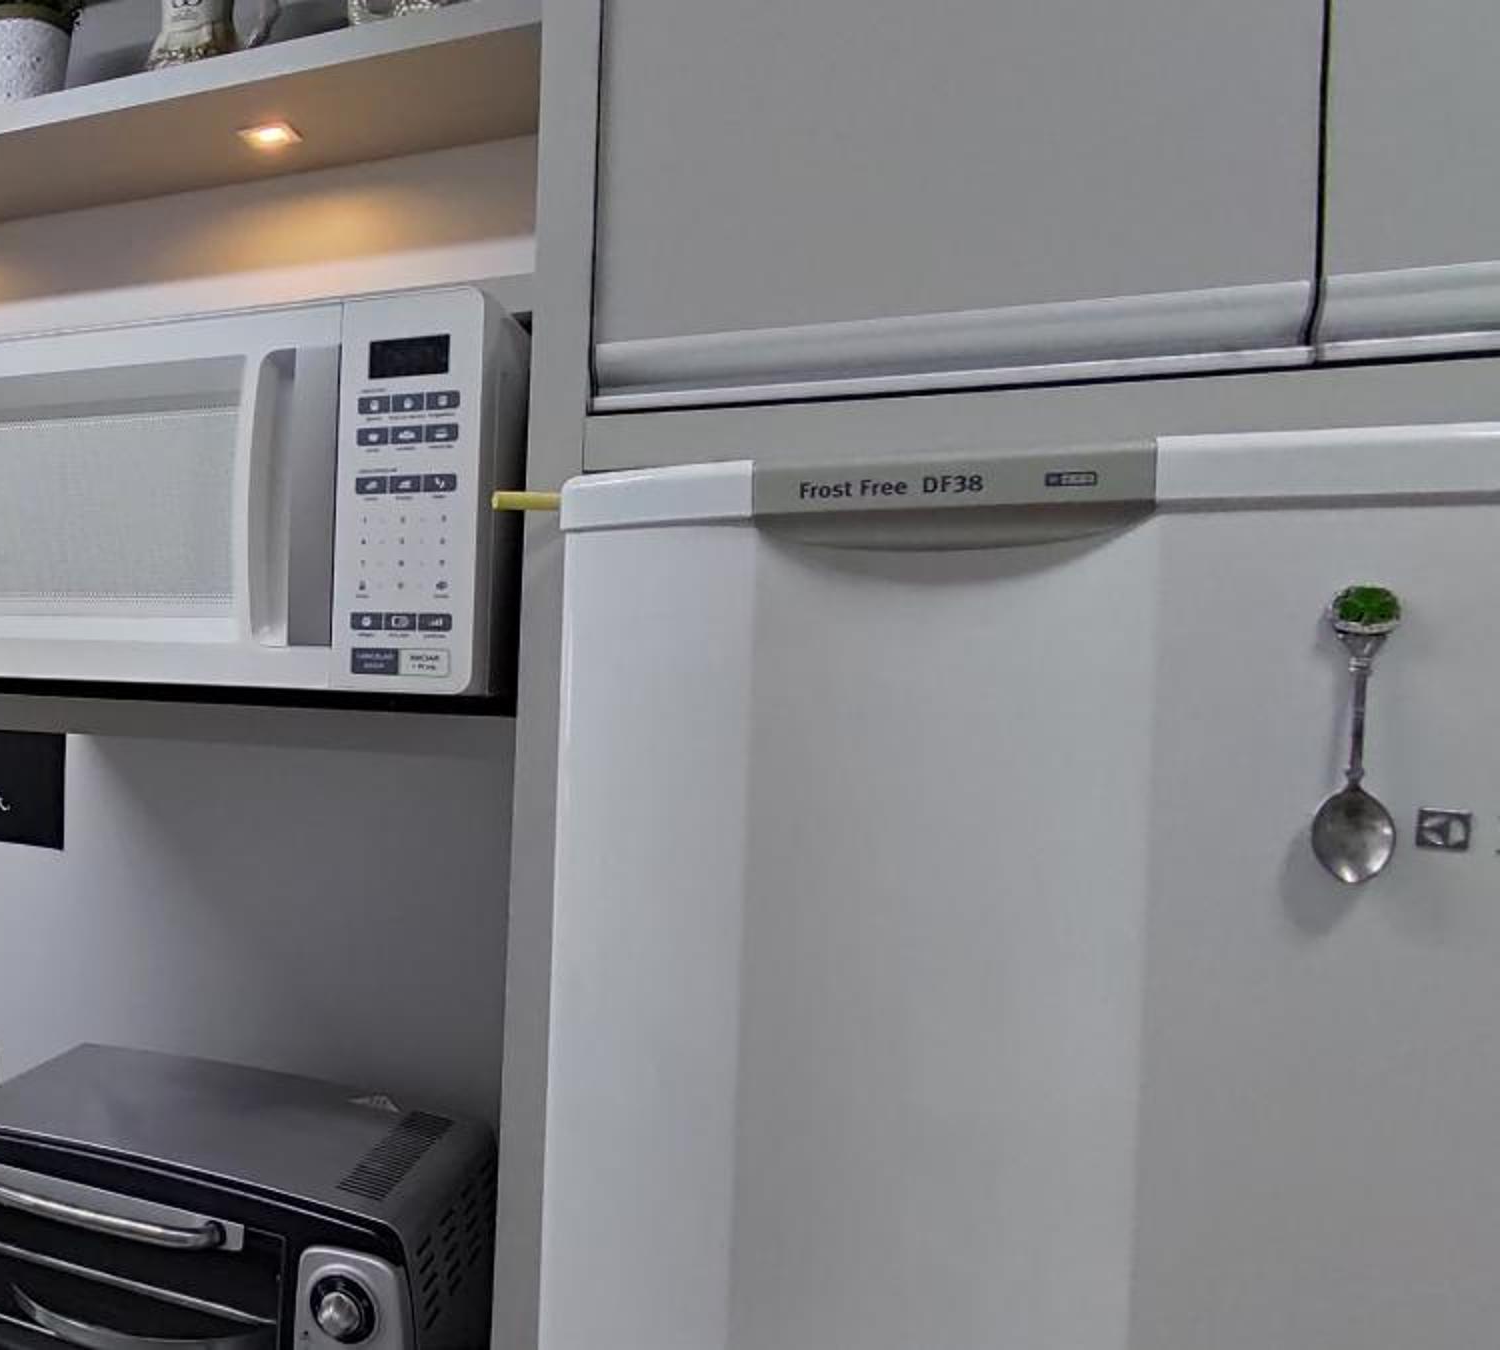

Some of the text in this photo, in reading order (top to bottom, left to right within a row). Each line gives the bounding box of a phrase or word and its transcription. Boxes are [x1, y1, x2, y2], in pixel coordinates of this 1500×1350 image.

[800, 474, 983, 500] Frost Free DF38
